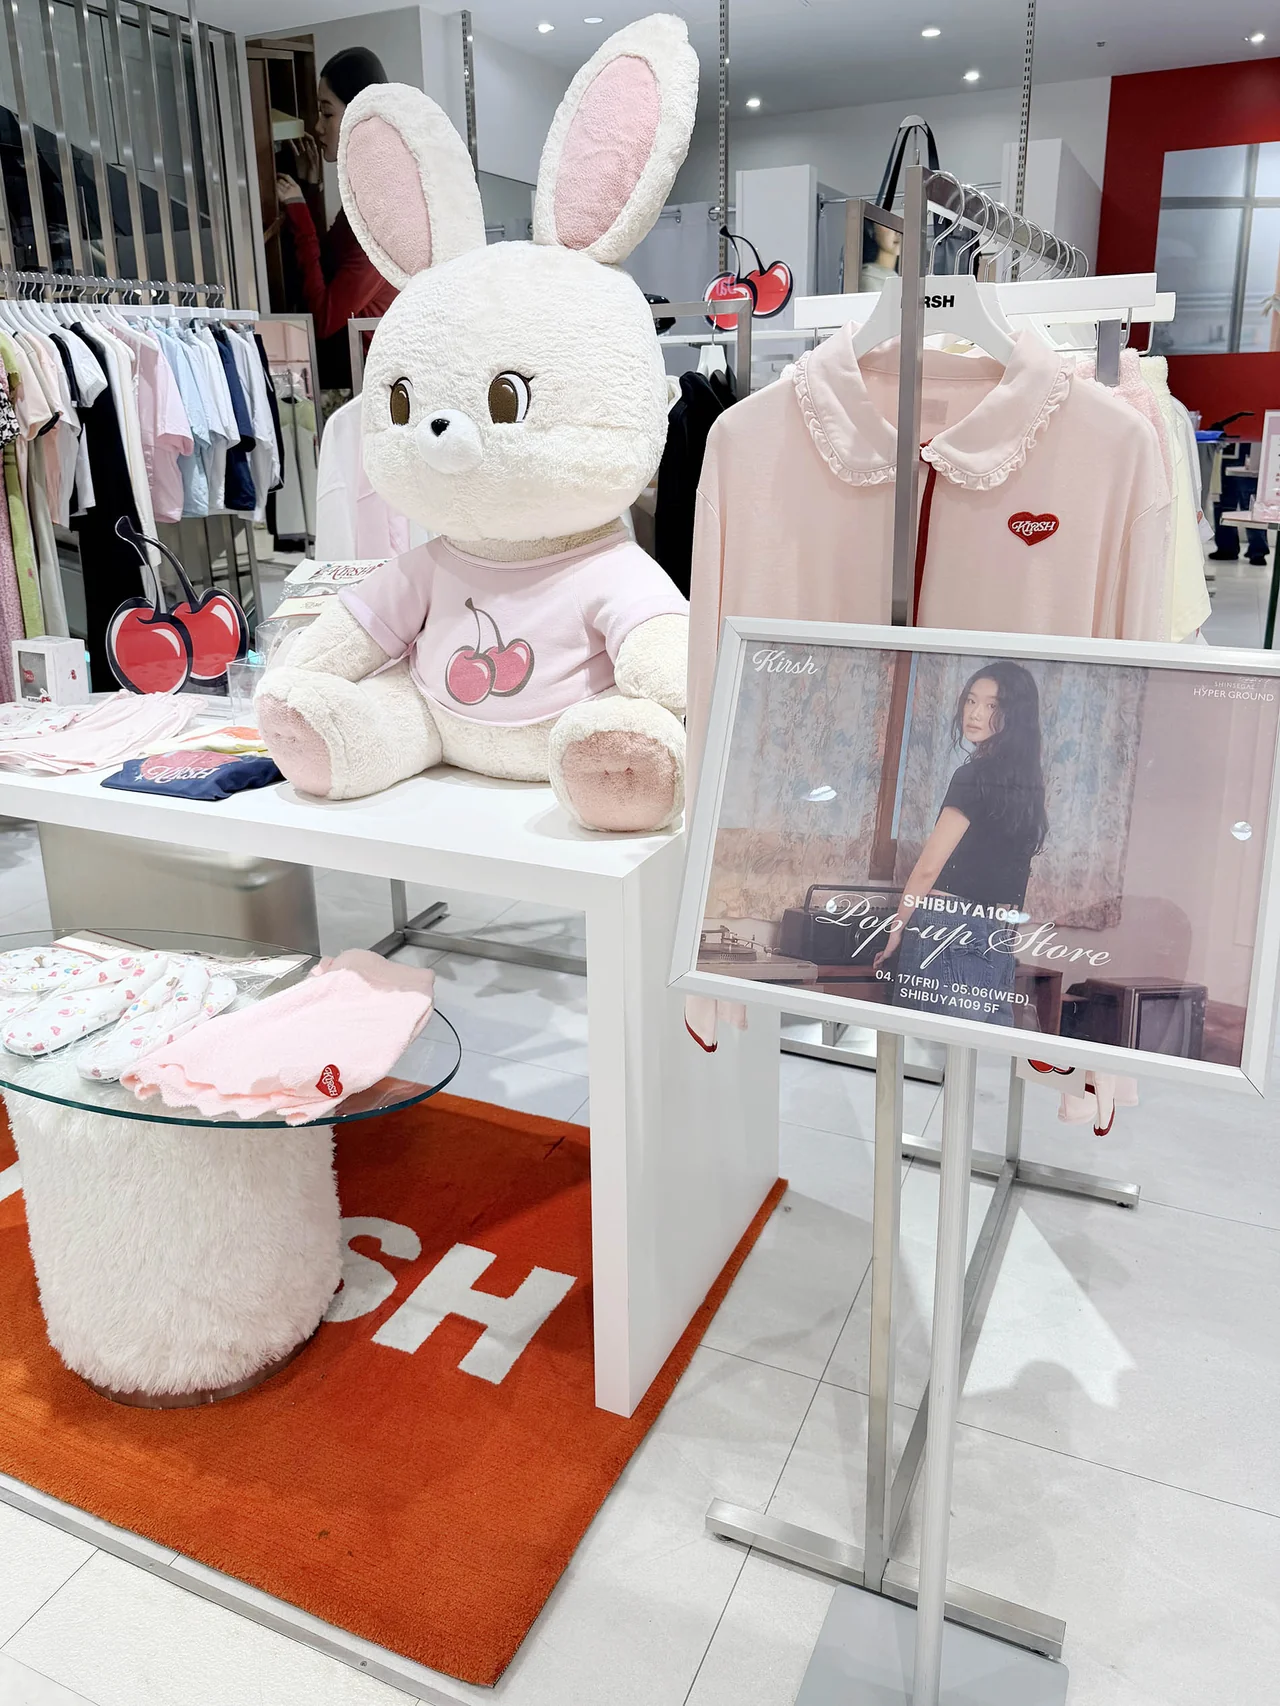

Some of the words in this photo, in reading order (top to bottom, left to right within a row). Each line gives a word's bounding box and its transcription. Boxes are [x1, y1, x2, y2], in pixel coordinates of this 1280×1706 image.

[1011, 520, 1056, 537] KIRSH
[752, 649, 818, 675] Kirsh
[1193, 687, 1226, 698] HYPER
[1227, 690, 1274, 702] GROUND
[903, 894, 1020, 924] SHIBUYA109
[983, 921, 1112, 966] Store
[899, 988, 981, 1011] SHIBUYA109
[983, 1003, 1000, 1014] 5F
[951, 982, 1029, 1006] 05.06(WED)
[322, 1066, 338, 1096] KIRSH
